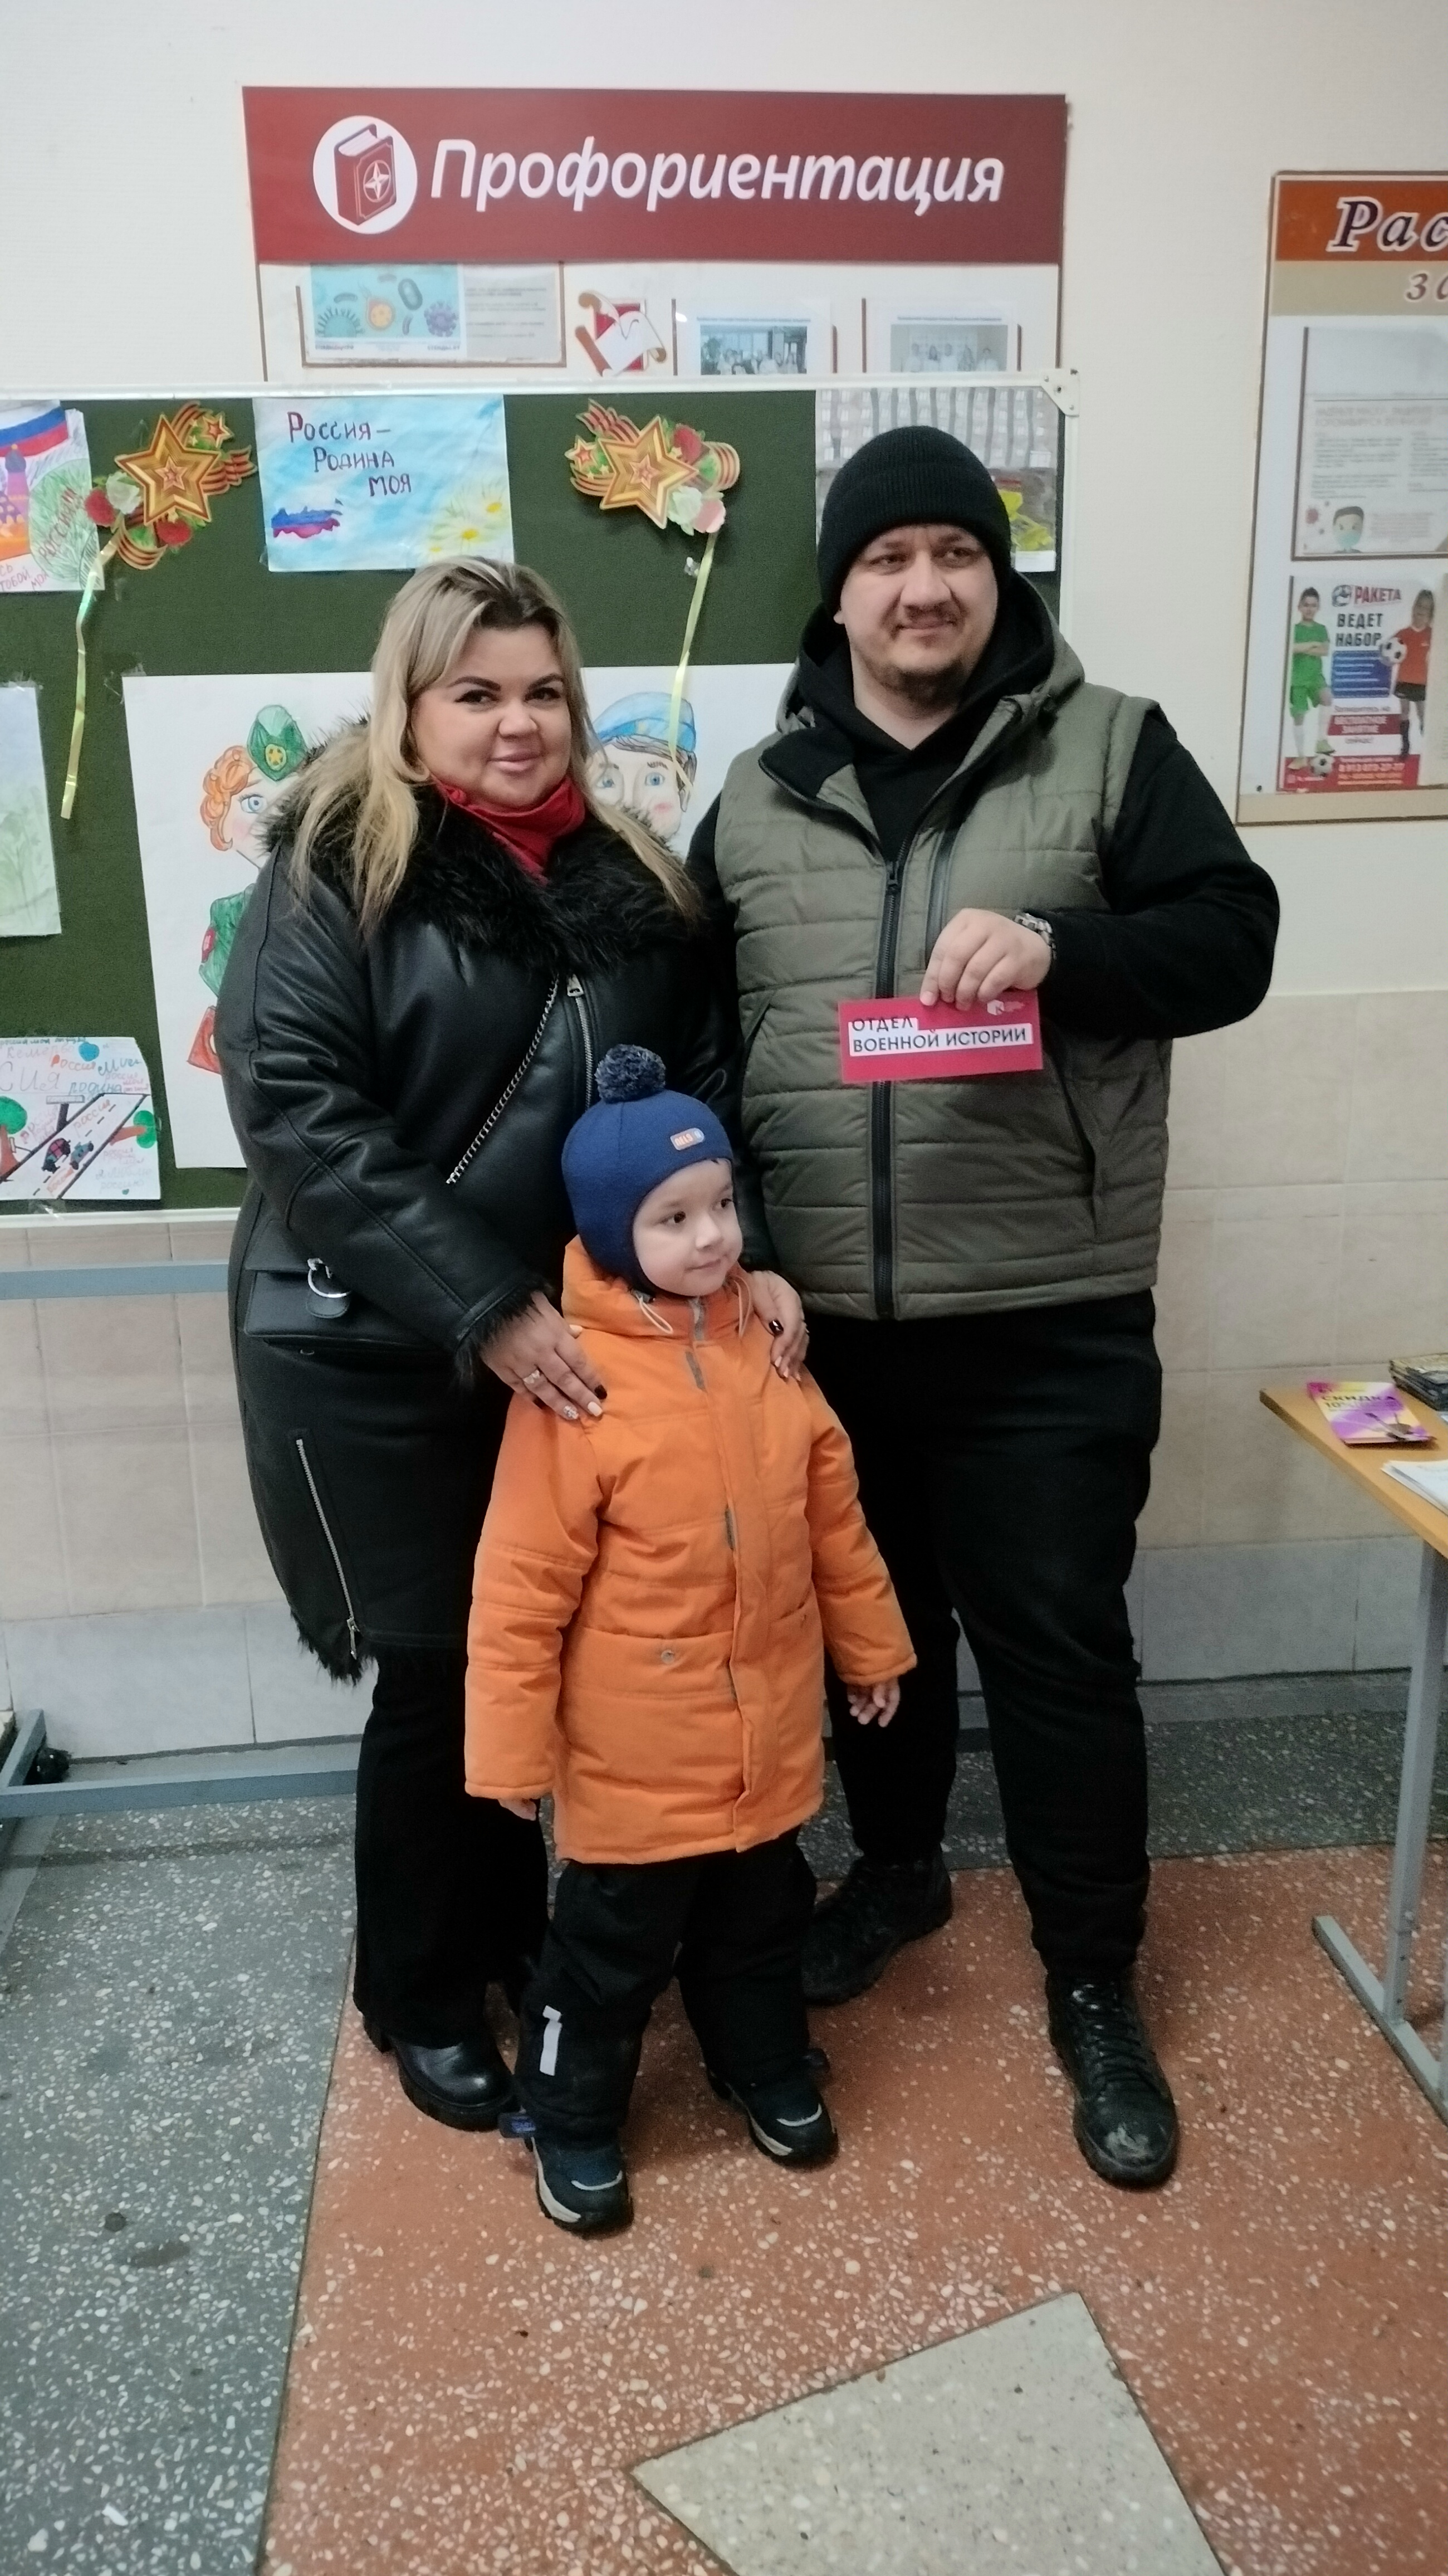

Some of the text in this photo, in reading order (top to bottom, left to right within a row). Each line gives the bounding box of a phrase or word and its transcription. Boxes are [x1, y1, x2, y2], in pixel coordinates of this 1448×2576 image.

[431, 136, 1004, 216] Профориентация
[1325, 196, 1448, 252] Рас
[1354, 585, 1402, 604] РАКЕТА
[1337, 613, 1383, 628] ВЕДЕТ
[1336, 632, 1382, 646] НАБОР
[852, 1016, 913, 1032] ОТДЕЛ
[853, 1027, 1026, 1052] ВОЕННОЙ ИСТОРИИ
